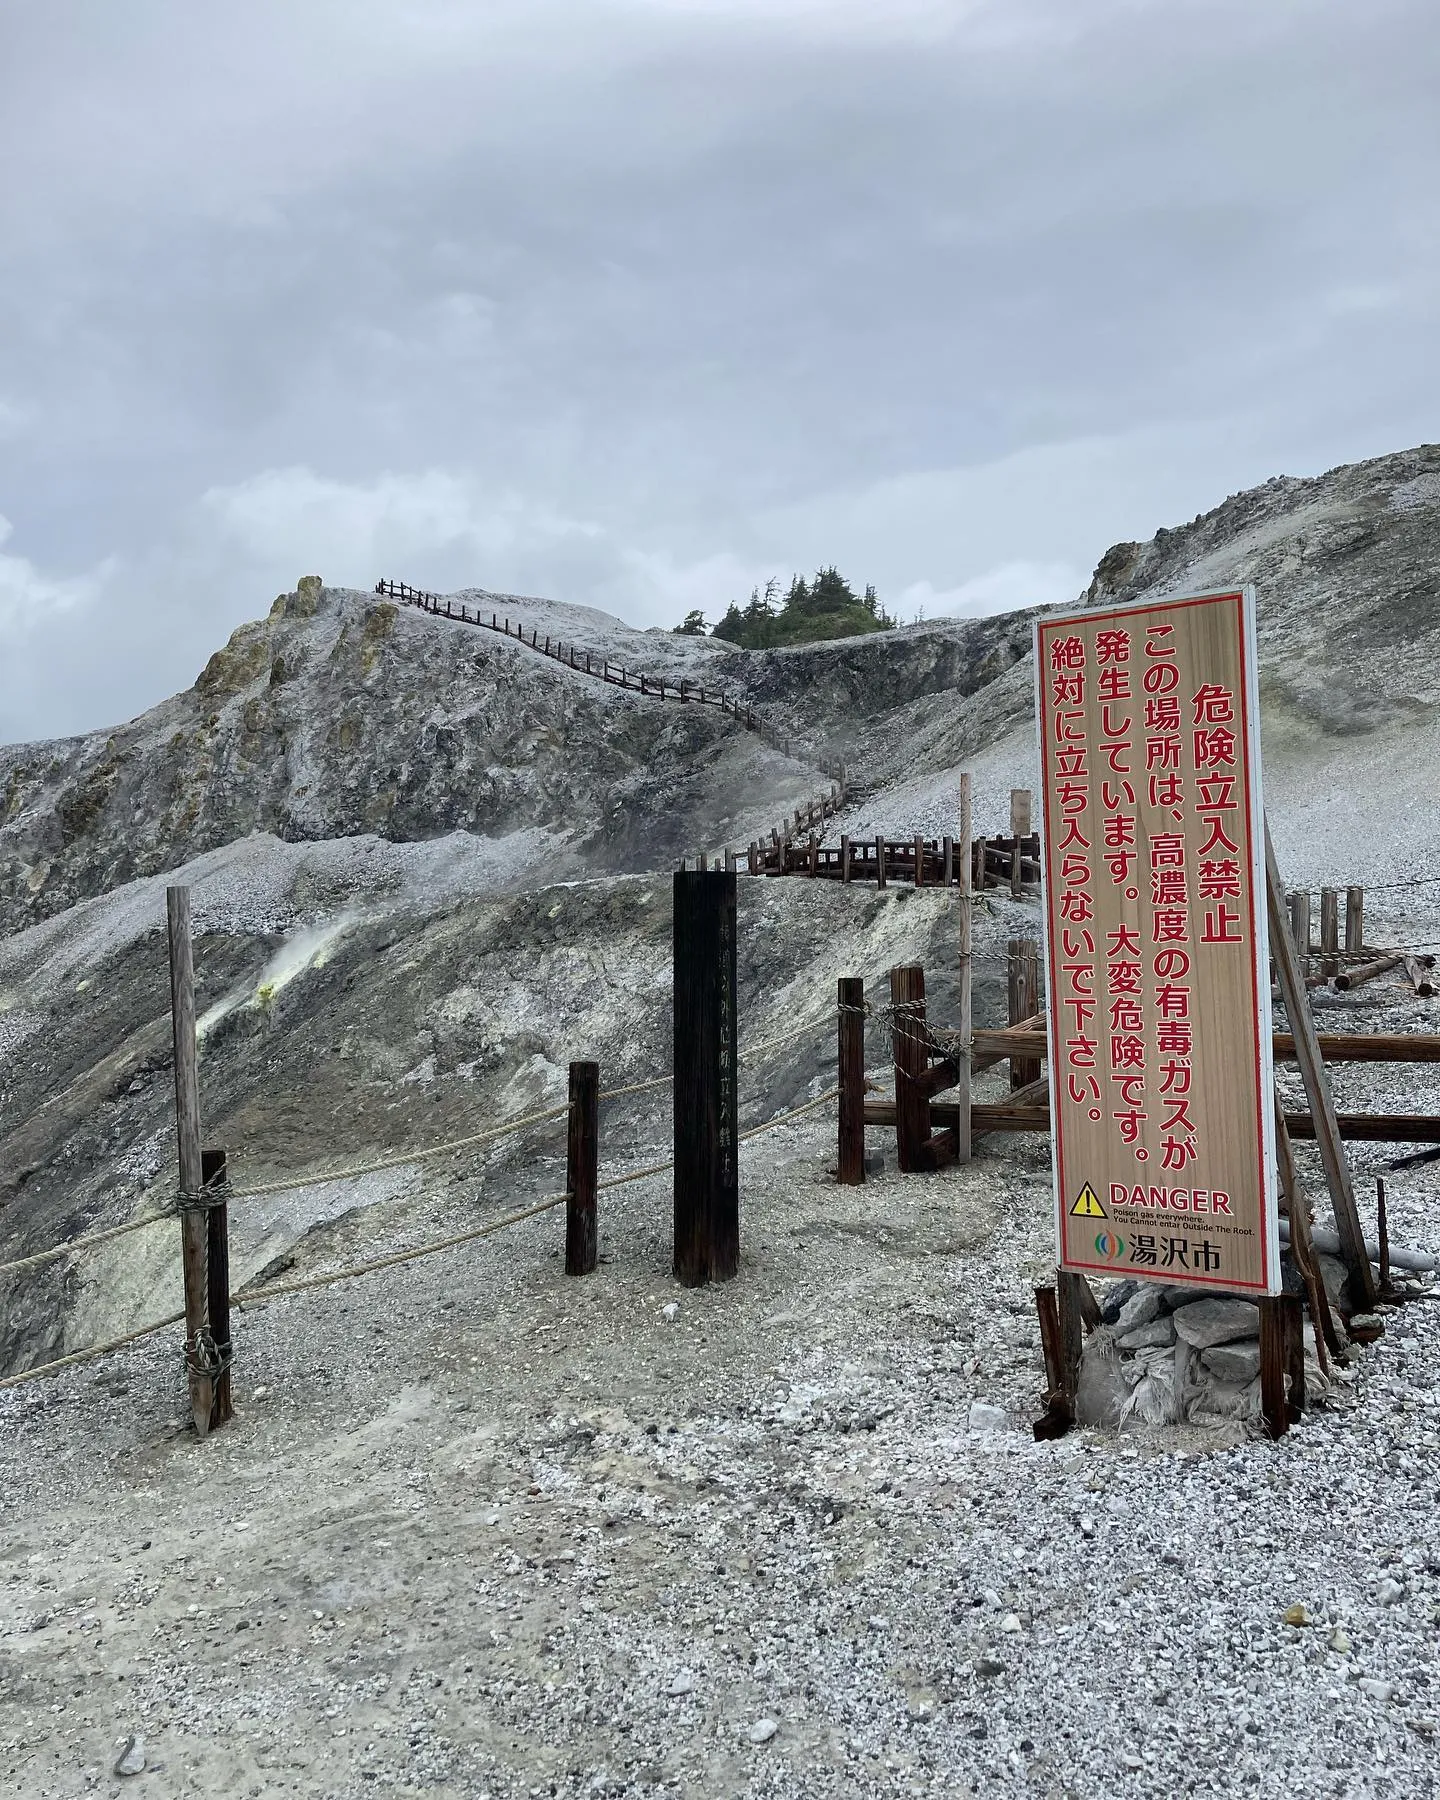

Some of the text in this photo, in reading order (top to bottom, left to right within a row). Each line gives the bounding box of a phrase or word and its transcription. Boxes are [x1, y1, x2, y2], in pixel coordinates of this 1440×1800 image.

[1191, 683, 1244, 944] 危険立入禁止
[1050, 636, 1102, 1123] 絶対に立ち入らないで下さい。
[1143, 624, 1198, 1172] この場所は、高濃度の有毒ガスが
[1109, 1183, 1234, 1216] DANGER
[1113, 1208, 1205, 1224] Poison gas everywhere.
[1114, 1215, 1128, 1224] You
[1130, 1218, 1157, 1227] Cannot
[1182, 1222, 1213, 1232] Outside
[1215, 1225, 1231, 1234] The
[1129, 1233, 1222, 1271] 湯沢市
